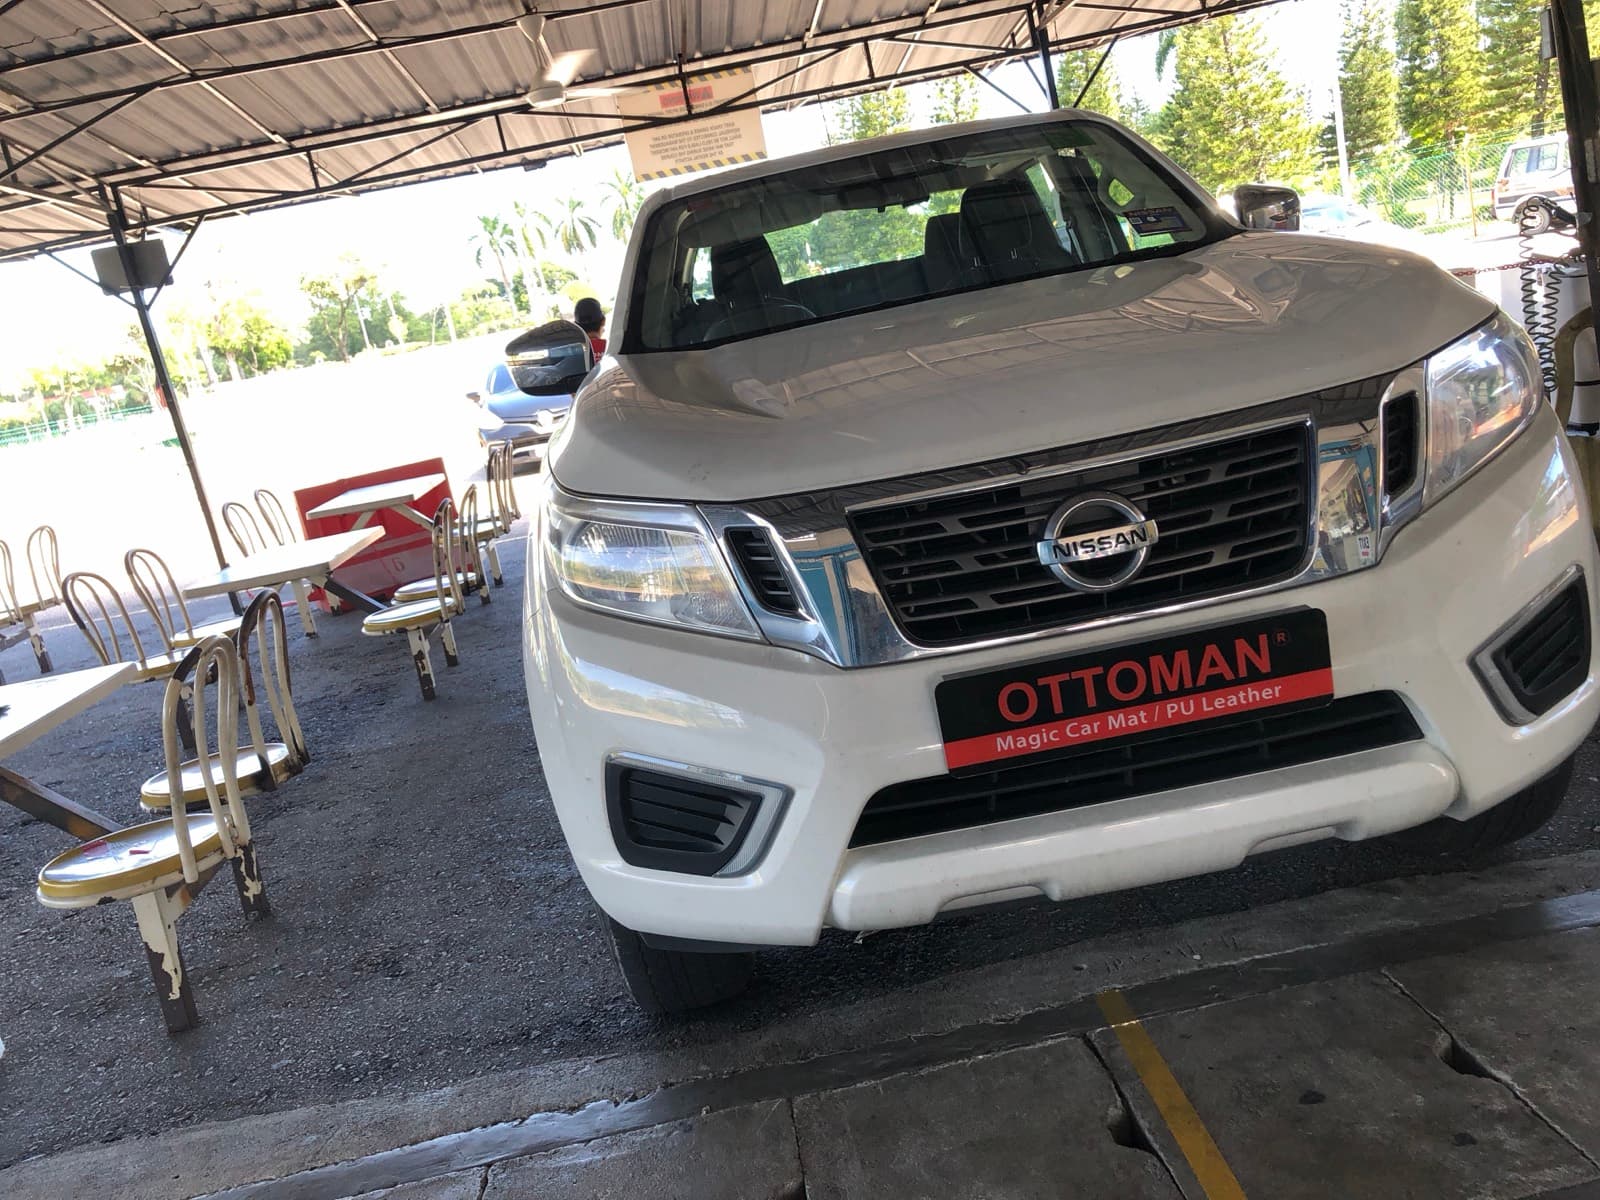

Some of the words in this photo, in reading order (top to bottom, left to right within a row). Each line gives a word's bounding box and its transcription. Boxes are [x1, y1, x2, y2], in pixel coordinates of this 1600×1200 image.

[1052, 527, 1148, 559] NISSAN
[998, 634, 1272, 722] OTTOMAN
[996, 727, 1059, 753] Magic
[1066, 721, 1101, 738] Car
[1107, 711, 1147, 730] Mat
[1154, 705, 1161, 722] /
[1167, 700, 1195, 719] PU
[1202, 684, 1282, 711] Leather
